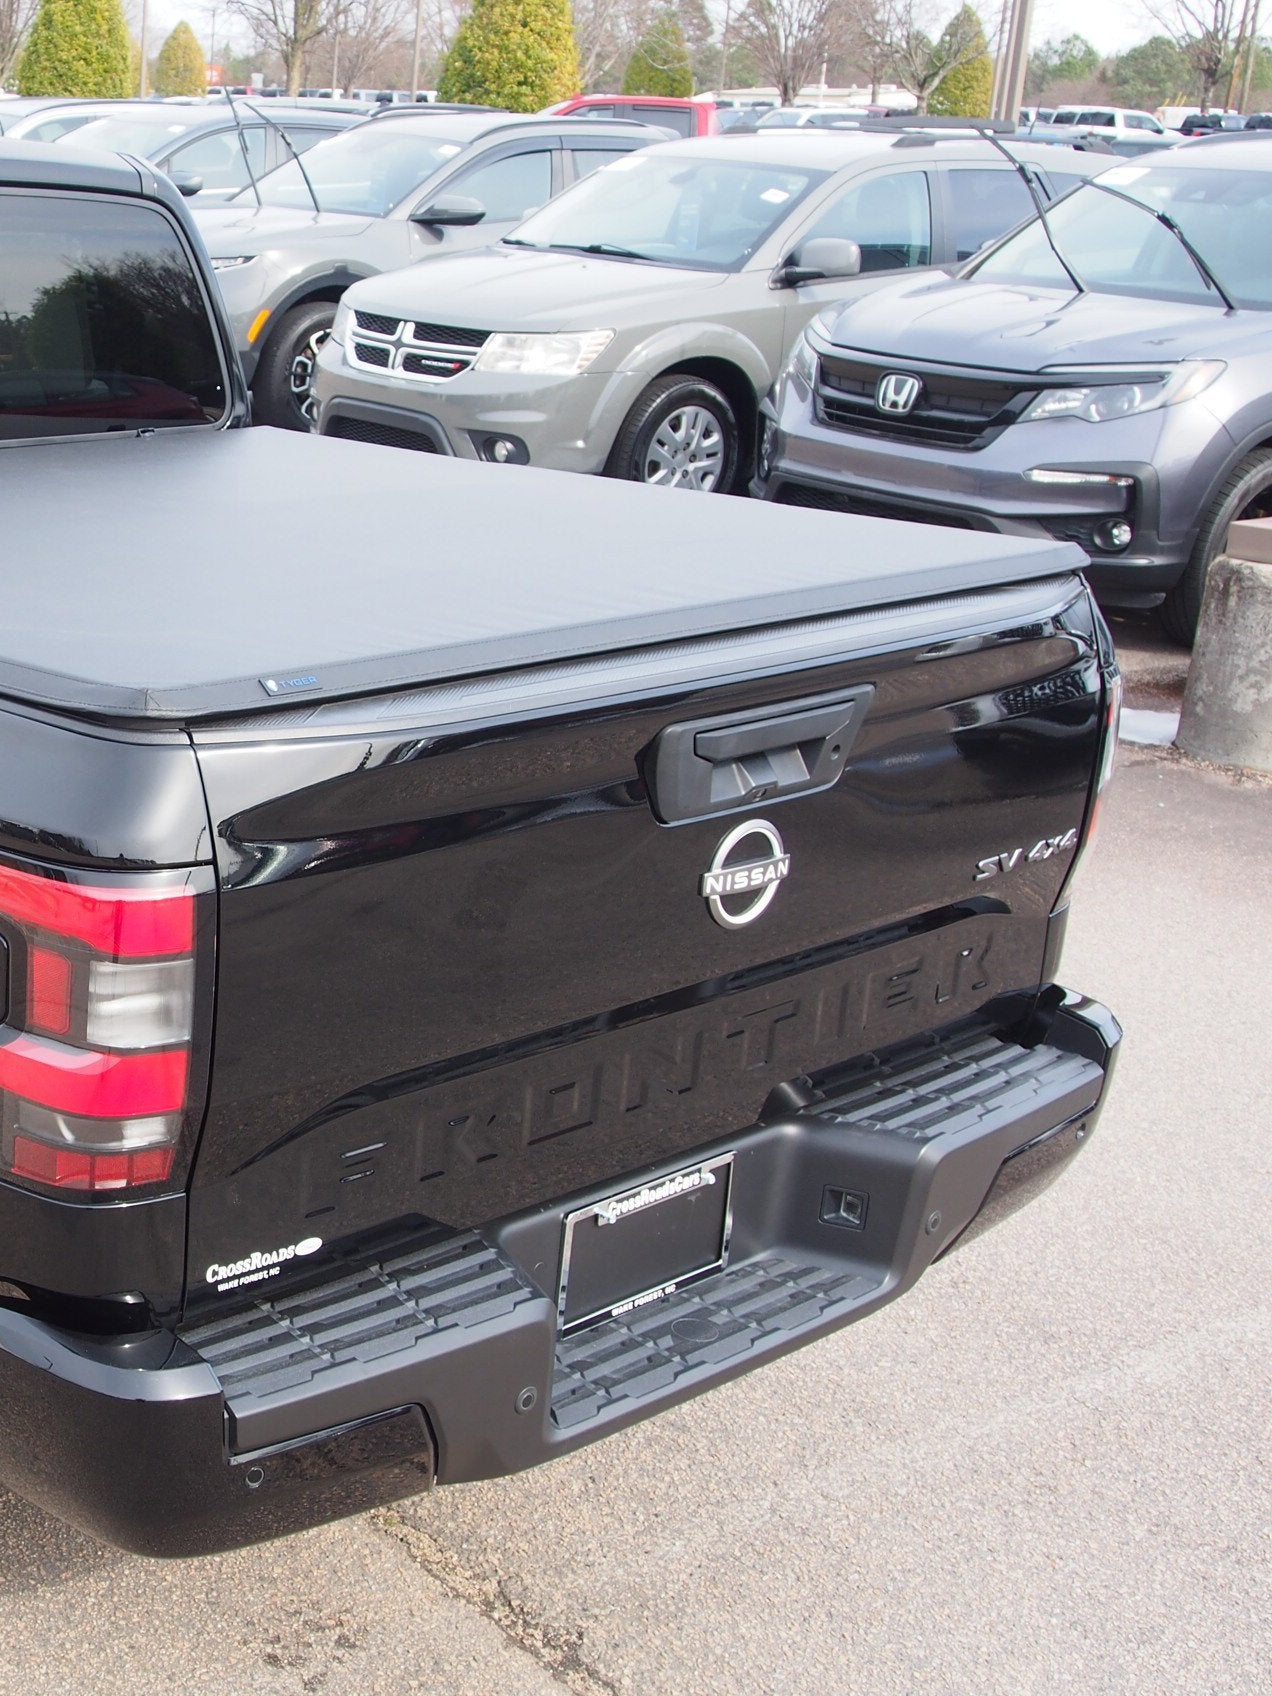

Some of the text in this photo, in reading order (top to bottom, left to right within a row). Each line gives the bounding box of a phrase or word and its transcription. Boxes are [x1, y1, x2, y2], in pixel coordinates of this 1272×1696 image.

[705, 859, 789, 894] NISSAN
[972, 848, 1023, 881] SV
[301, 932, 996, 1218] FRONTIER
[217, 1279, 239, 1292] WAKE
[268, 1266, 281, 1277] NC
